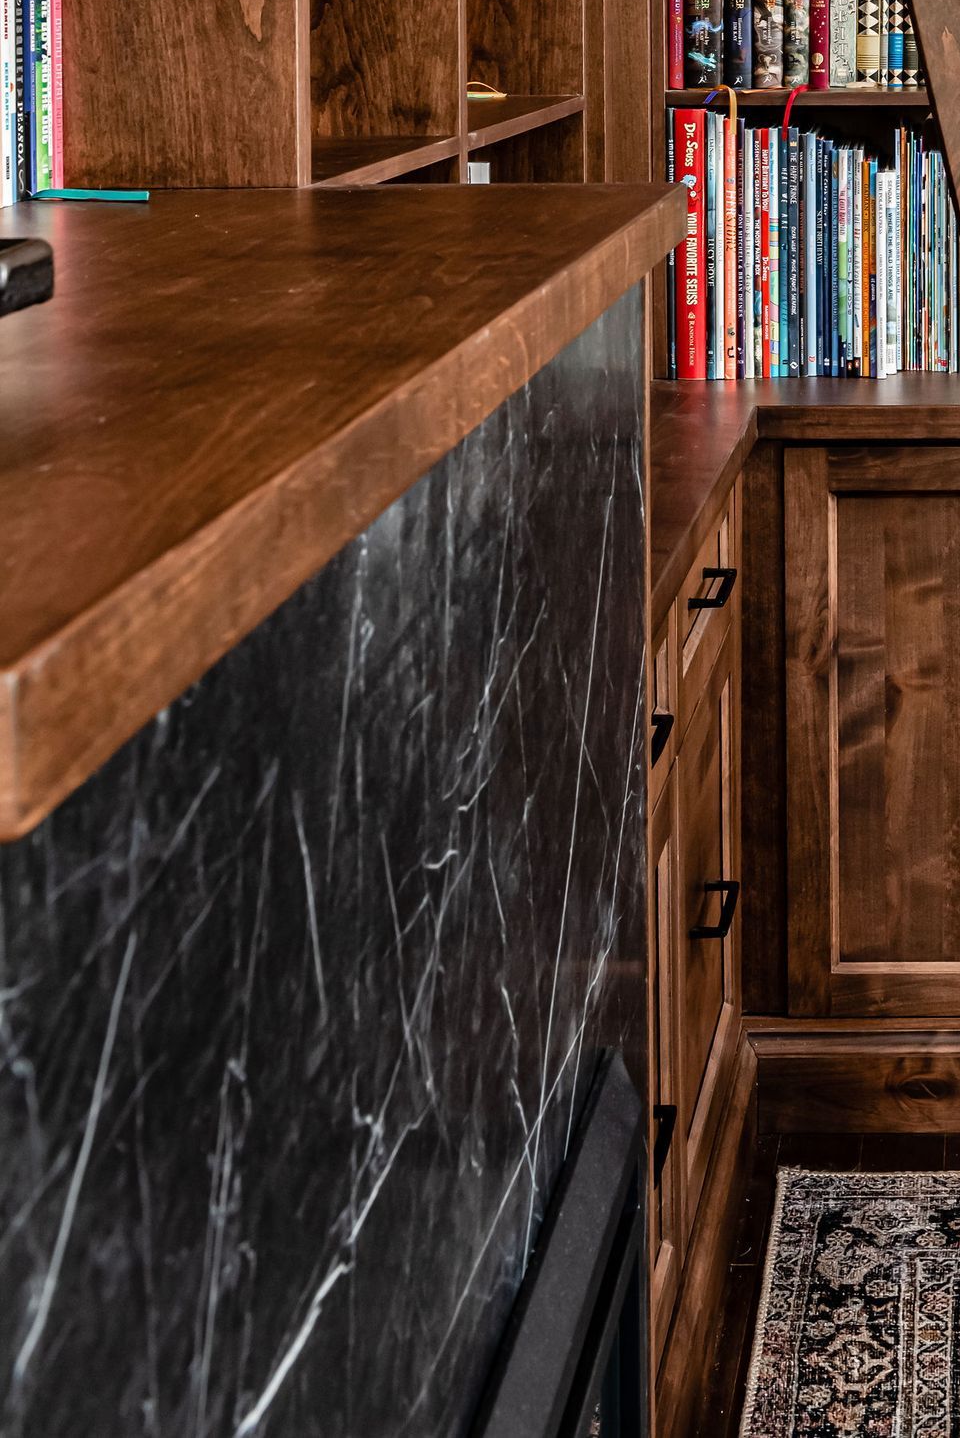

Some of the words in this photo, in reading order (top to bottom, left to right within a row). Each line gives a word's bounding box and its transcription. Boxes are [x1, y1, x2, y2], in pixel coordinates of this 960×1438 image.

[684, 122, 696, 140] Dr.
[684, 141, 697, 167] Seuss
[686, 211, 697, 234] YOUR
[686, 237, 697, 275] FAVORITE
[686, 278, 697, 305] SEUSS
